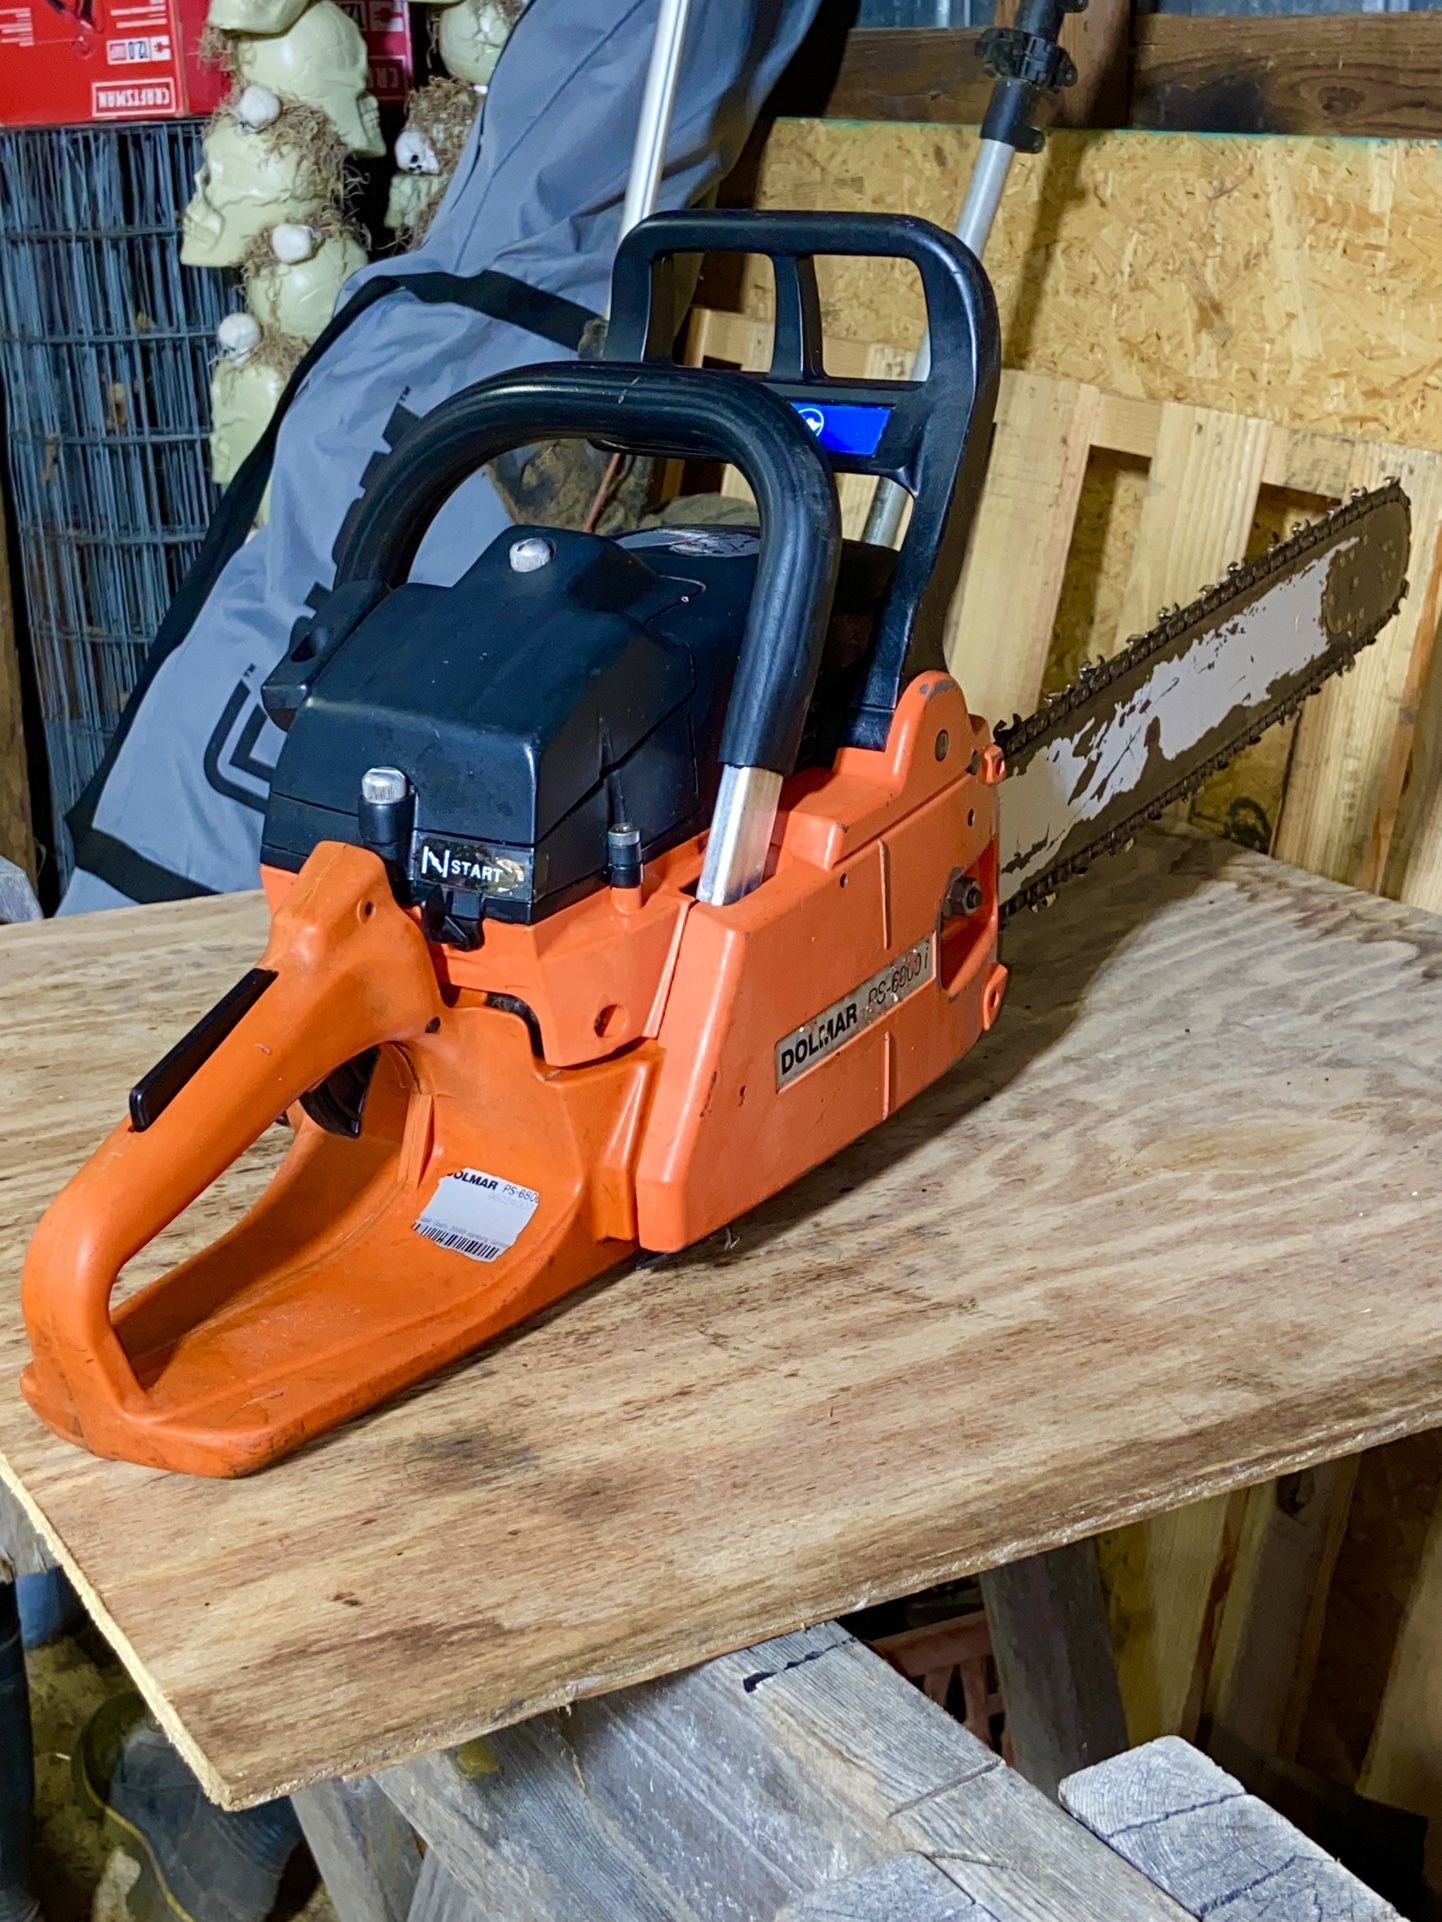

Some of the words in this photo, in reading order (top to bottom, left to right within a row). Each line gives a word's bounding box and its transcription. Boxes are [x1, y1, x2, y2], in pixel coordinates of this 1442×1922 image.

[98, 87, 170, 108] CRAFTSMAN
[451, 859, 503, 882] START
[781, 1002, 858, 1076] DOLMAR
